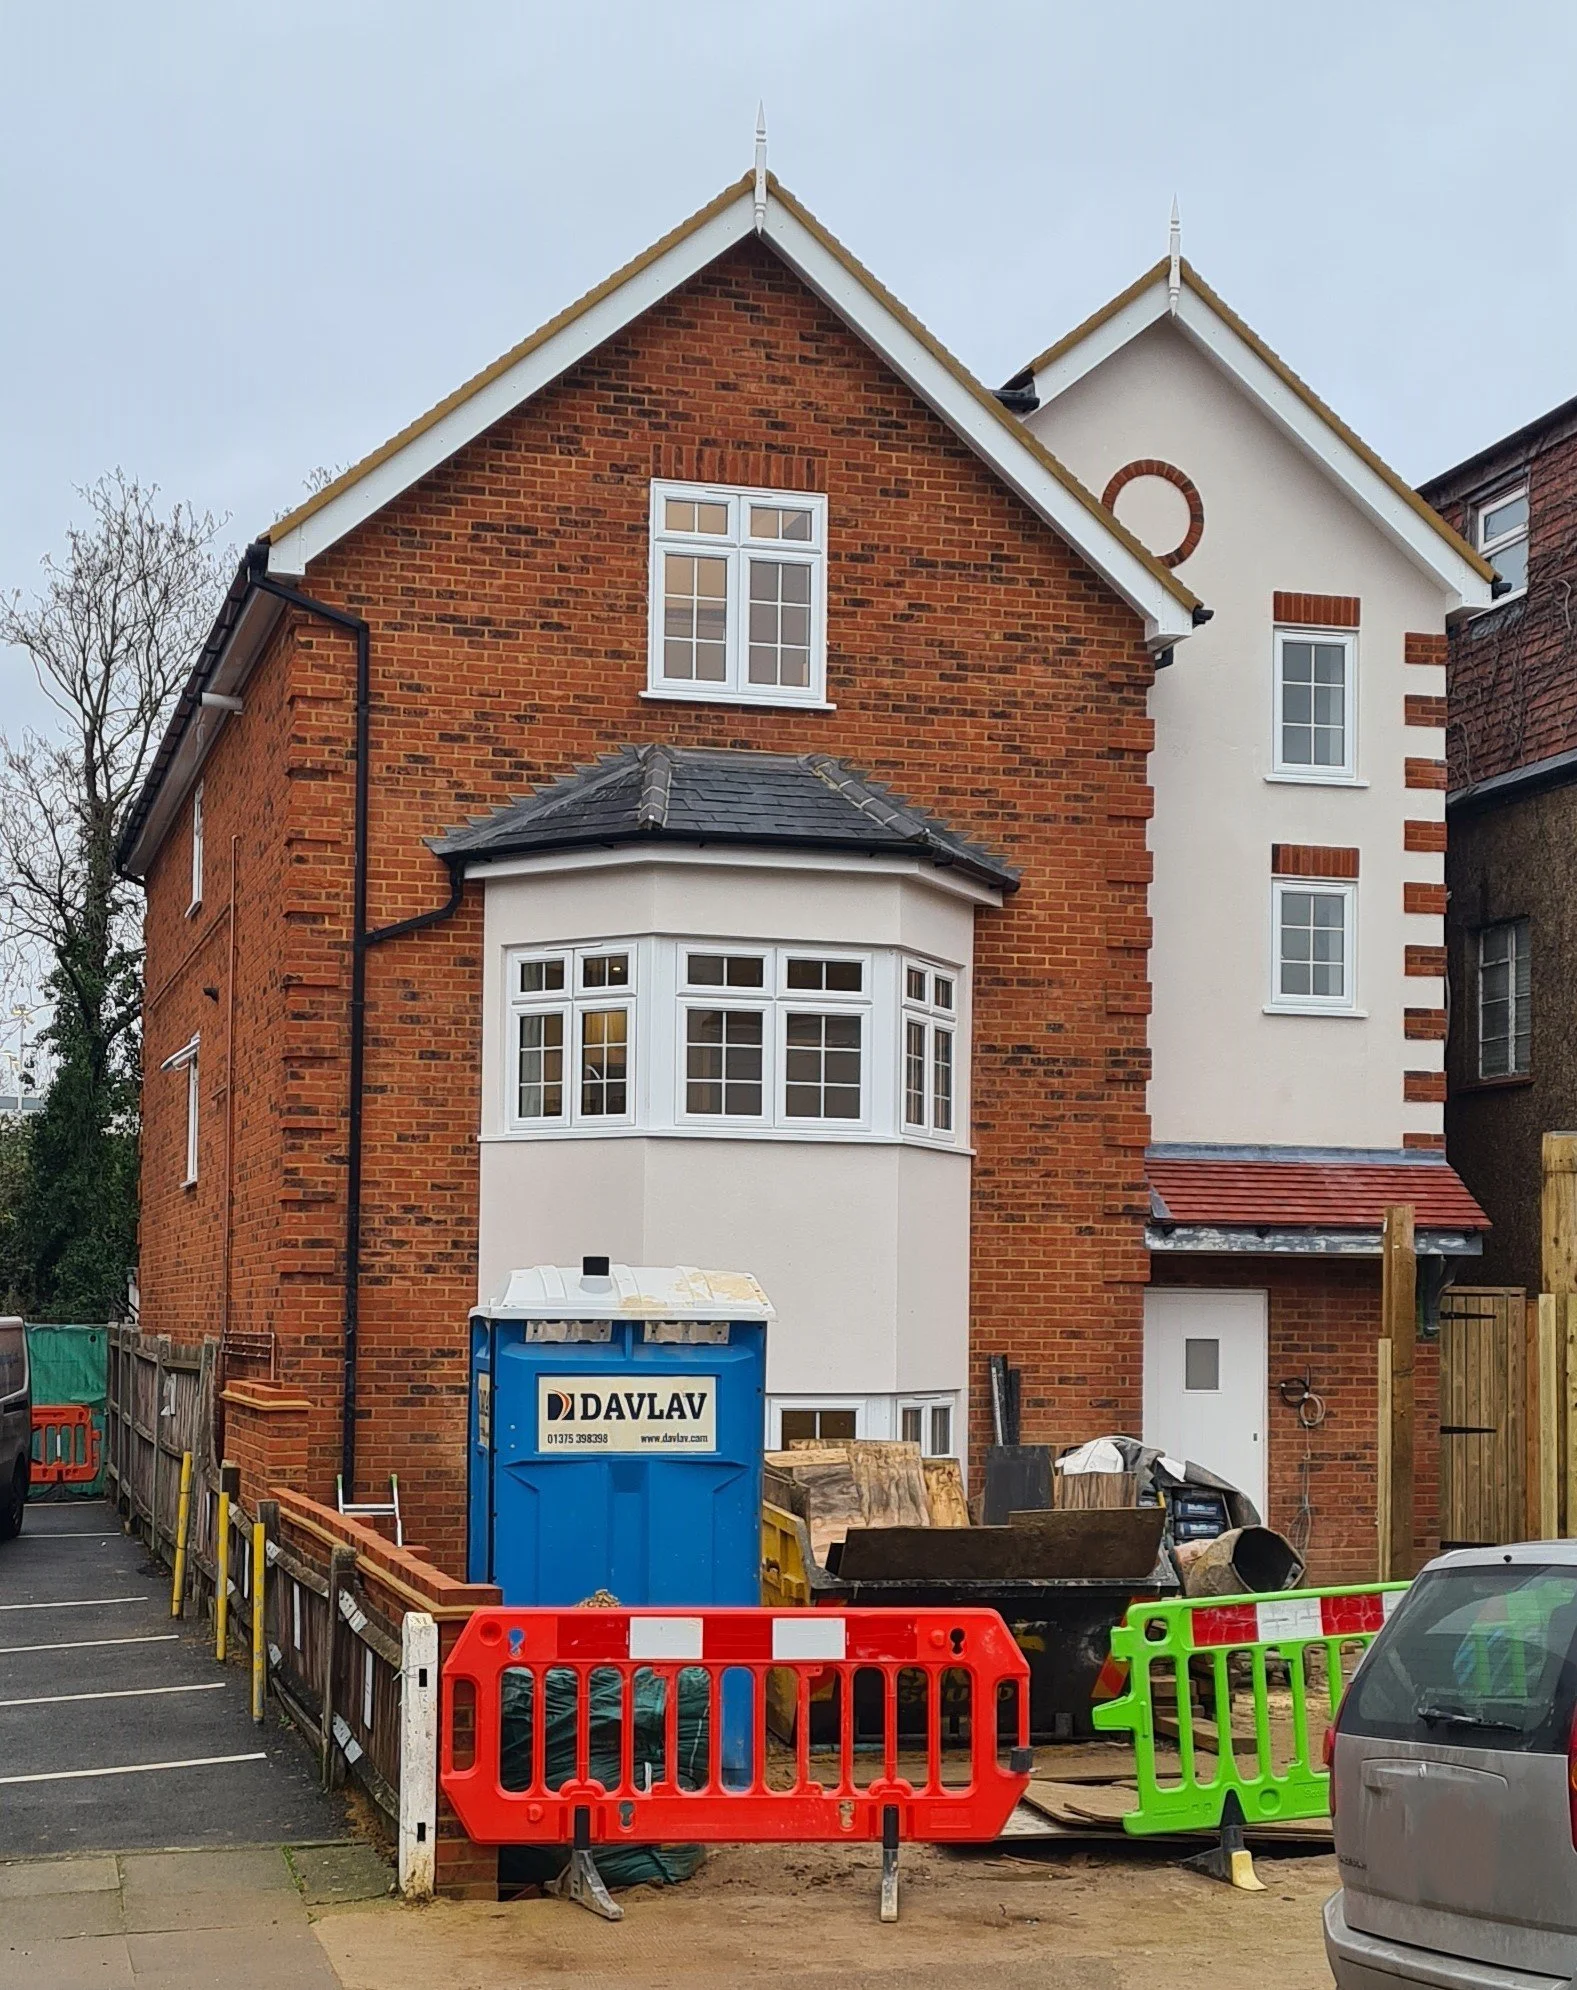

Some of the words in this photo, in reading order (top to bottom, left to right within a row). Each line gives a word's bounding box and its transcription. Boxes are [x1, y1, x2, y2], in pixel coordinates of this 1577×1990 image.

[580, 1392, 708, 1420] DAVLAV
[547, 1433, 574, 1444] 01375
[576, 1433, 609, 1444] 398398
[641, 1432, 708, 1443] www.davlav.com
